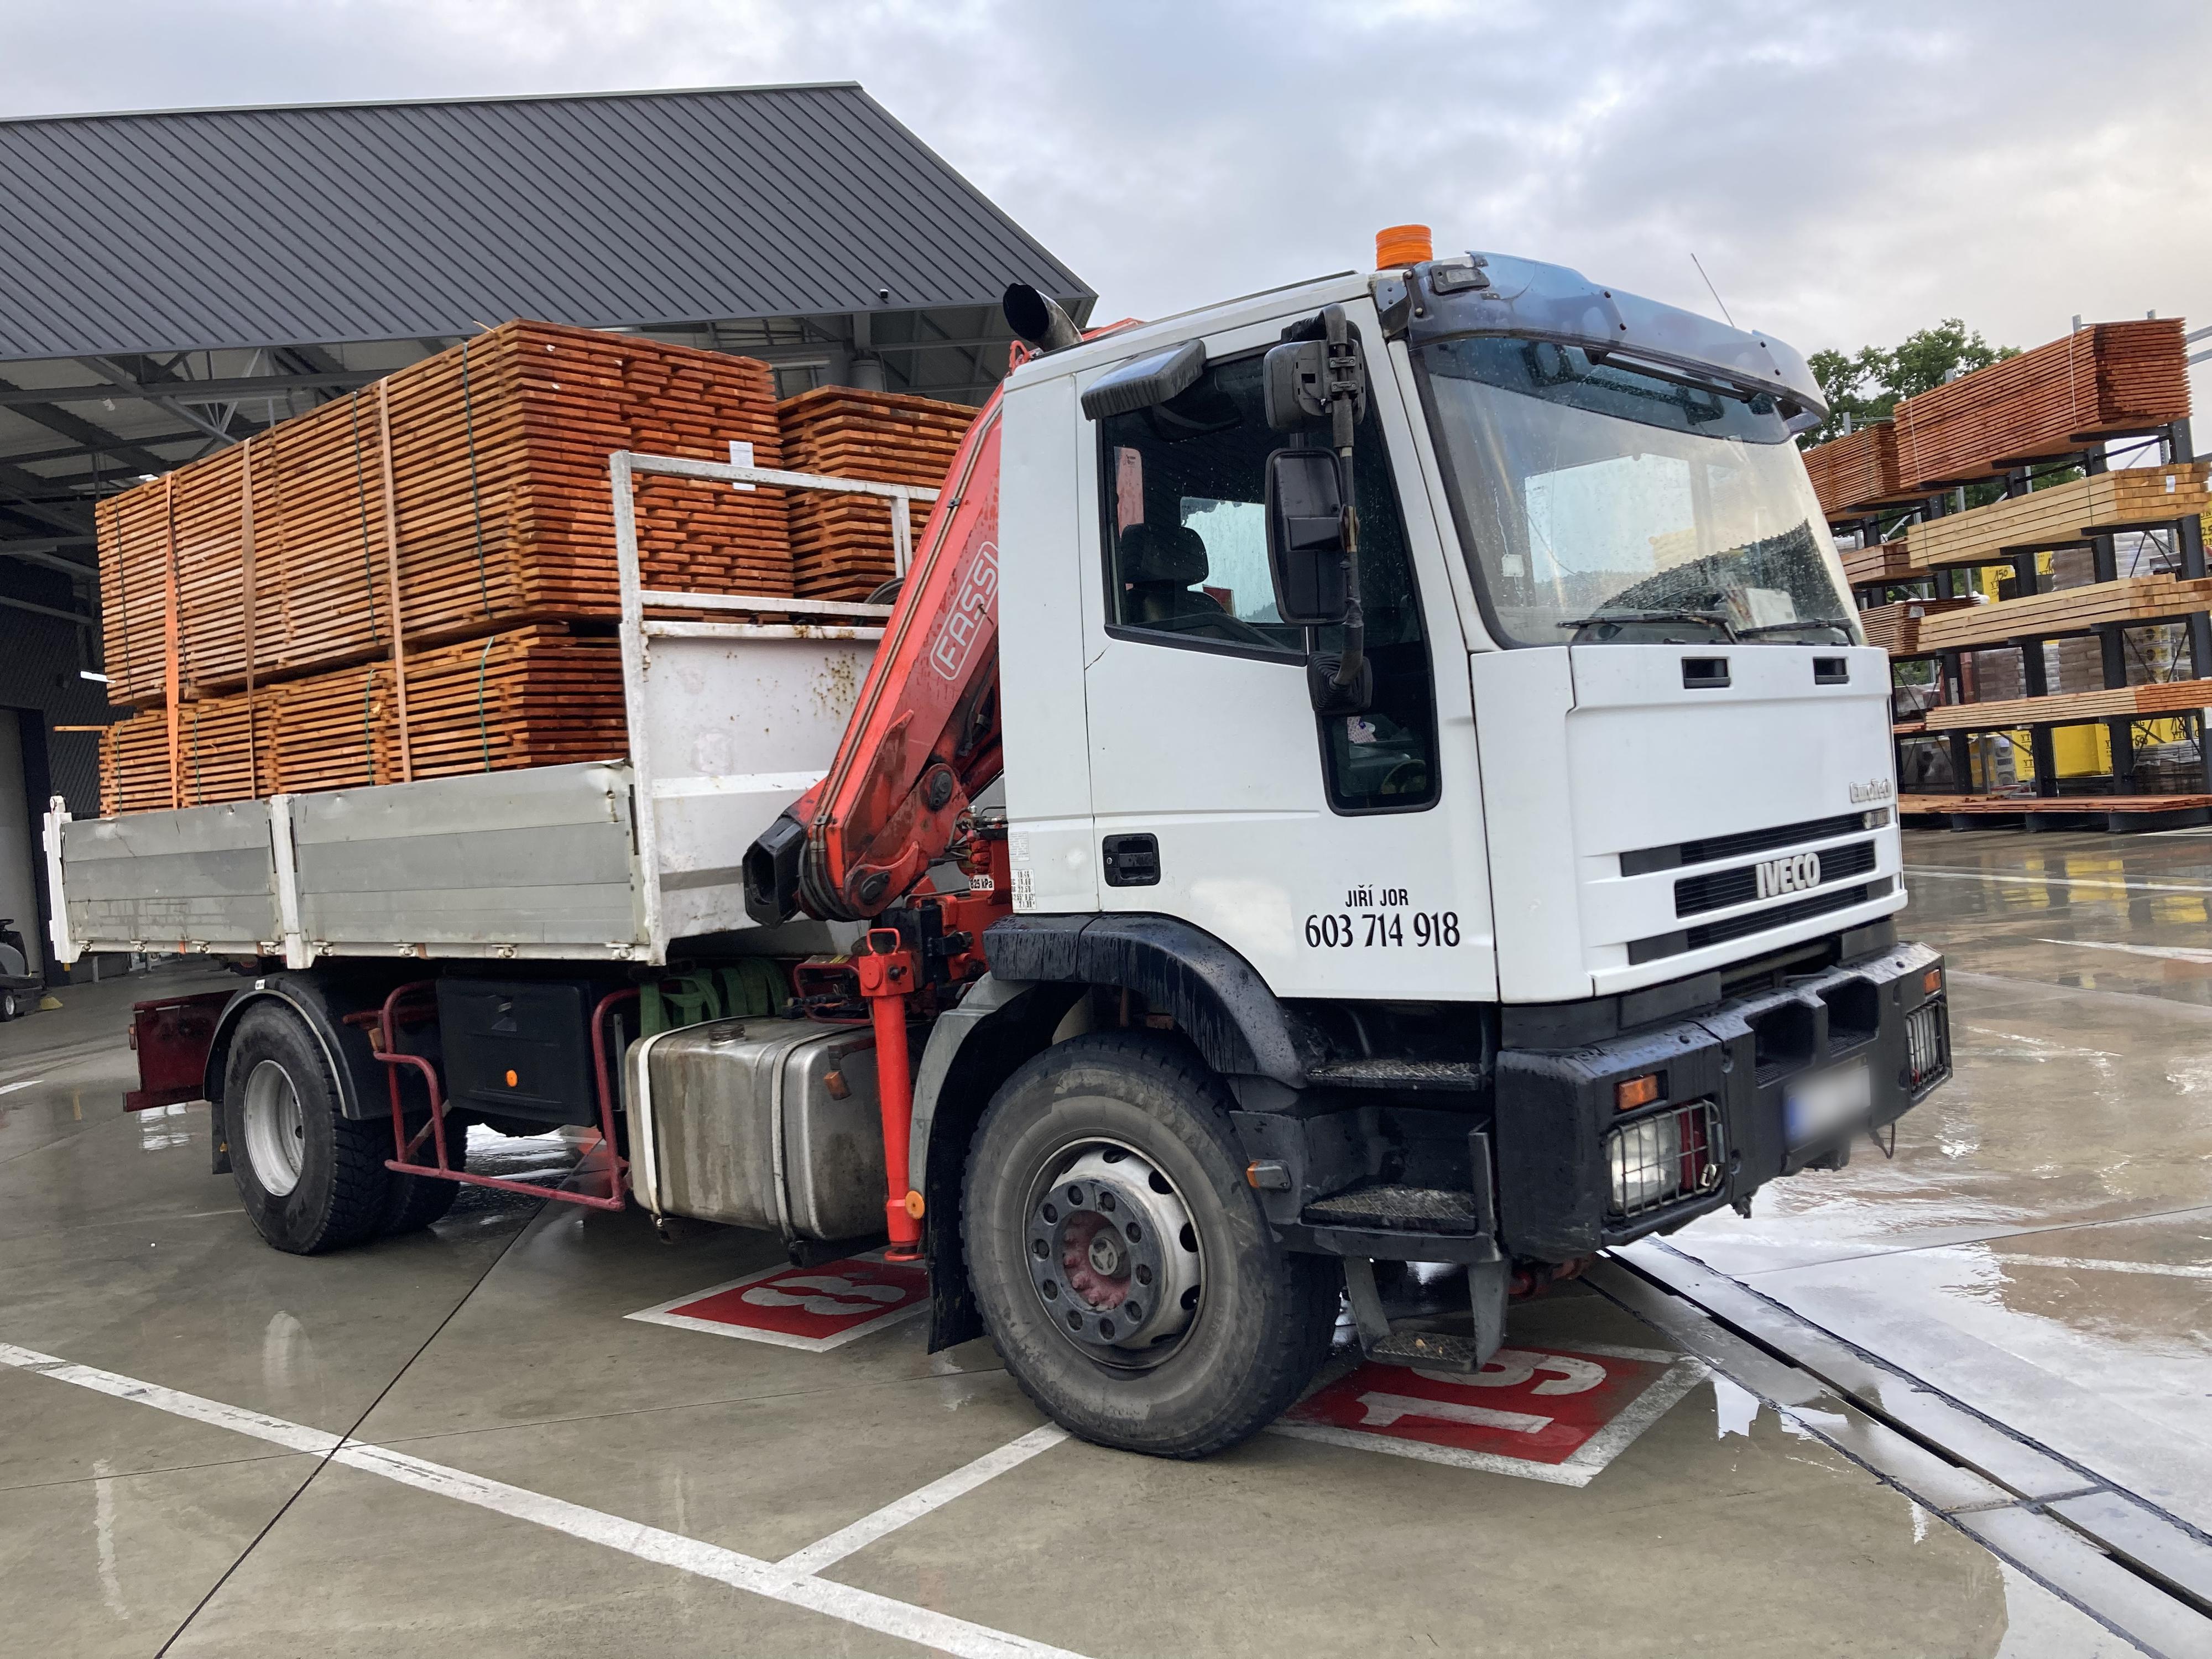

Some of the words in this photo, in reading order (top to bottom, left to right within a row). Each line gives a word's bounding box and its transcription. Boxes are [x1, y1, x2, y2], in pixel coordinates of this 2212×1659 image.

[936, 551, 999, 670] FASSI
[981, 878, 993, 889] kPa
[1755, 852, 1821, 899] IVECO
[1345, 884, 1374, 907] JIŘÍ
[1379, 888, 1409, 906] JOR
[1305, 914, 1353, 948] 603
[1361, 913, 1403, 947] 714
[1413, 911, 1460, 947] 918
